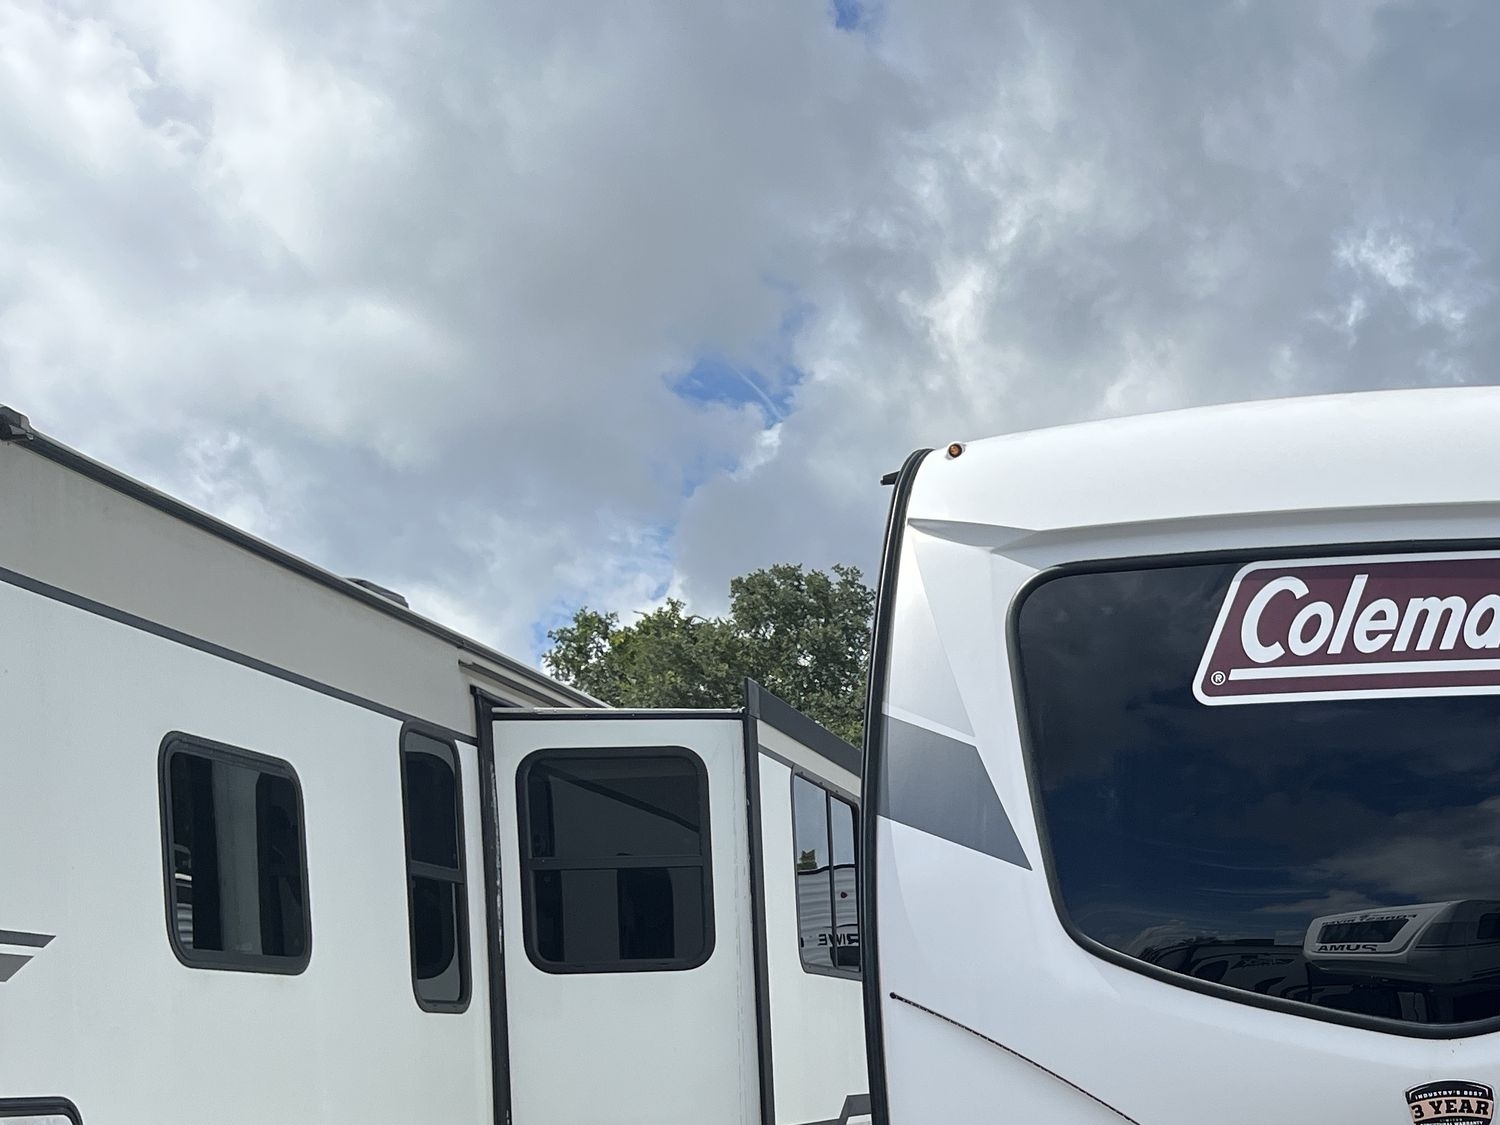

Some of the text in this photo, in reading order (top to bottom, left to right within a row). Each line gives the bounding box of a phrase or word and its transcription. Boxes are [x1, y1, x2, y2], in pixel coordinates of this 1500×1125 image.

[1415, 1090, 1461, 1100] INDUSTRY'S
[1411, 1099, 1490, 1119] 3 YEAR
